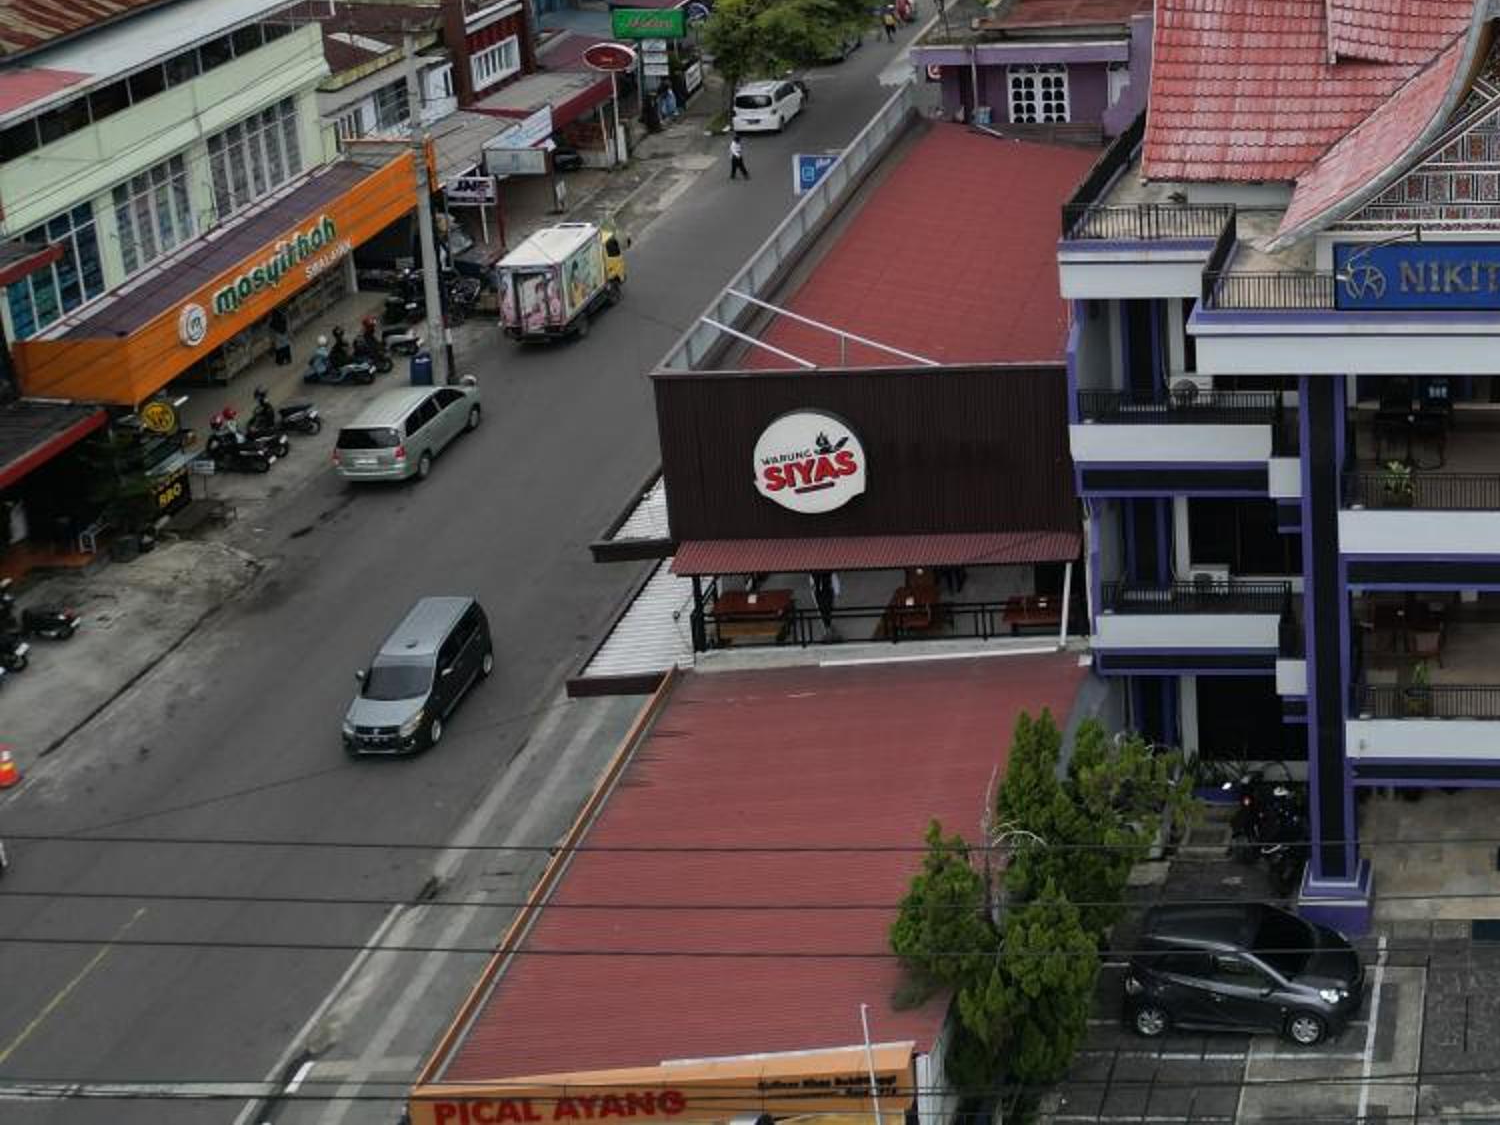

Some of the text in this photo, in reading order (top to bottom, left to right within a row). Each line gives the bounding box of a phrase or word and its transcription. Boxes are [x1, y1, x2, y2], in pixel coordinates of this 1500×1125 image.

[761, 449, 813, 466] WARUNG
[764, 450, 857, 492] SIYAS
[434, 1089, 687, 1125] PICAL AYANG
